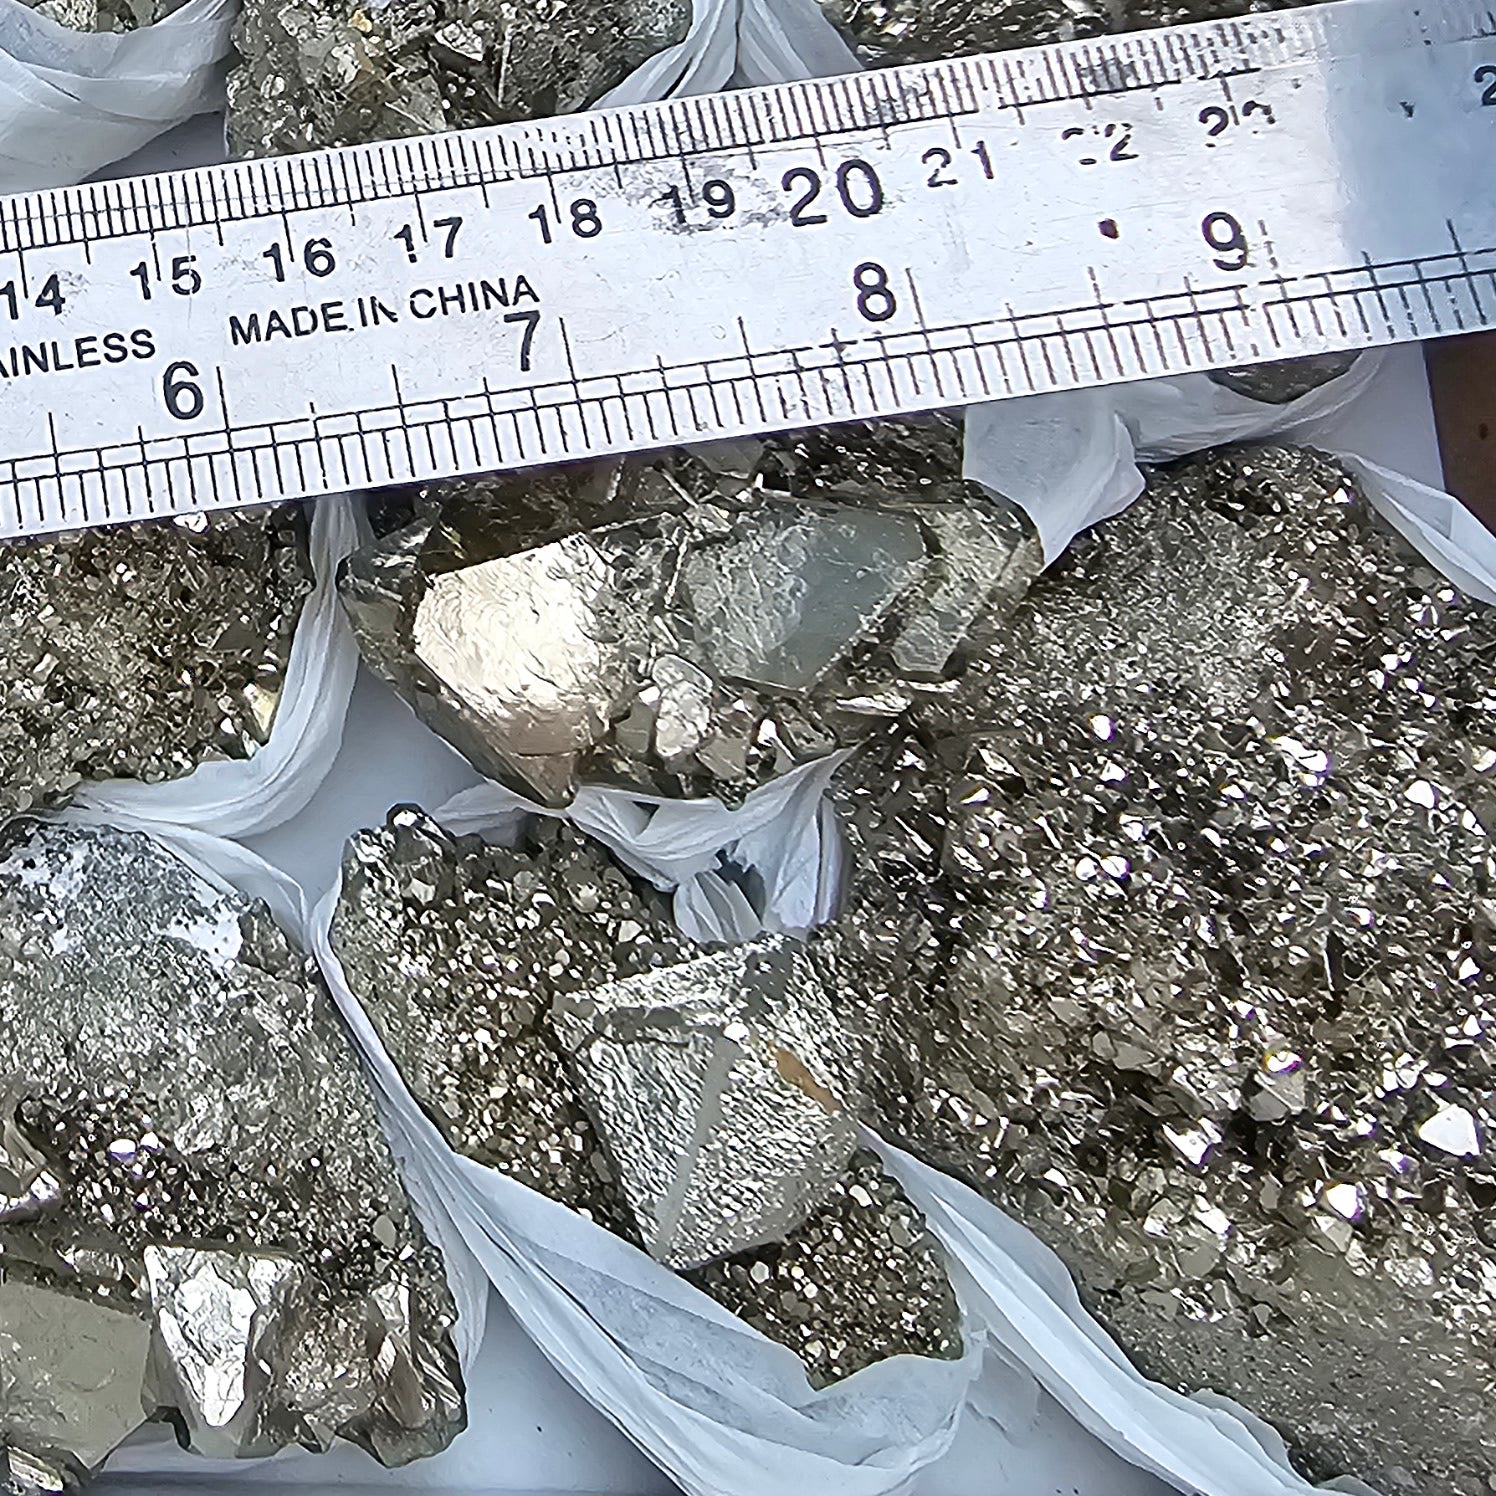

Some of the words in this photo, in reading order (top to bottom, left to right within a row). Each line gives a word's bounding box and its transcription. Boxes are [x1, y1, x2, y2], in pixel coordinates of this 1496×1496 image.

[129, 254, 203, 301] 15
[262, 237, 337, 283] 16
[395, 216, 464, 263] 17
[528, 197, 602, 245] 18
[662, 179, 736, 224] 19
[782, 158, 884, 227] 20
[921, 139, 994, 188] 21
[410, 273, 540, 319] CHINA
[163, 359, 204, 420] 6
[504, 310, 541, 372] 7
[853, 261, 897, 322] 8
[1201, 210, 1250, 271] 9
